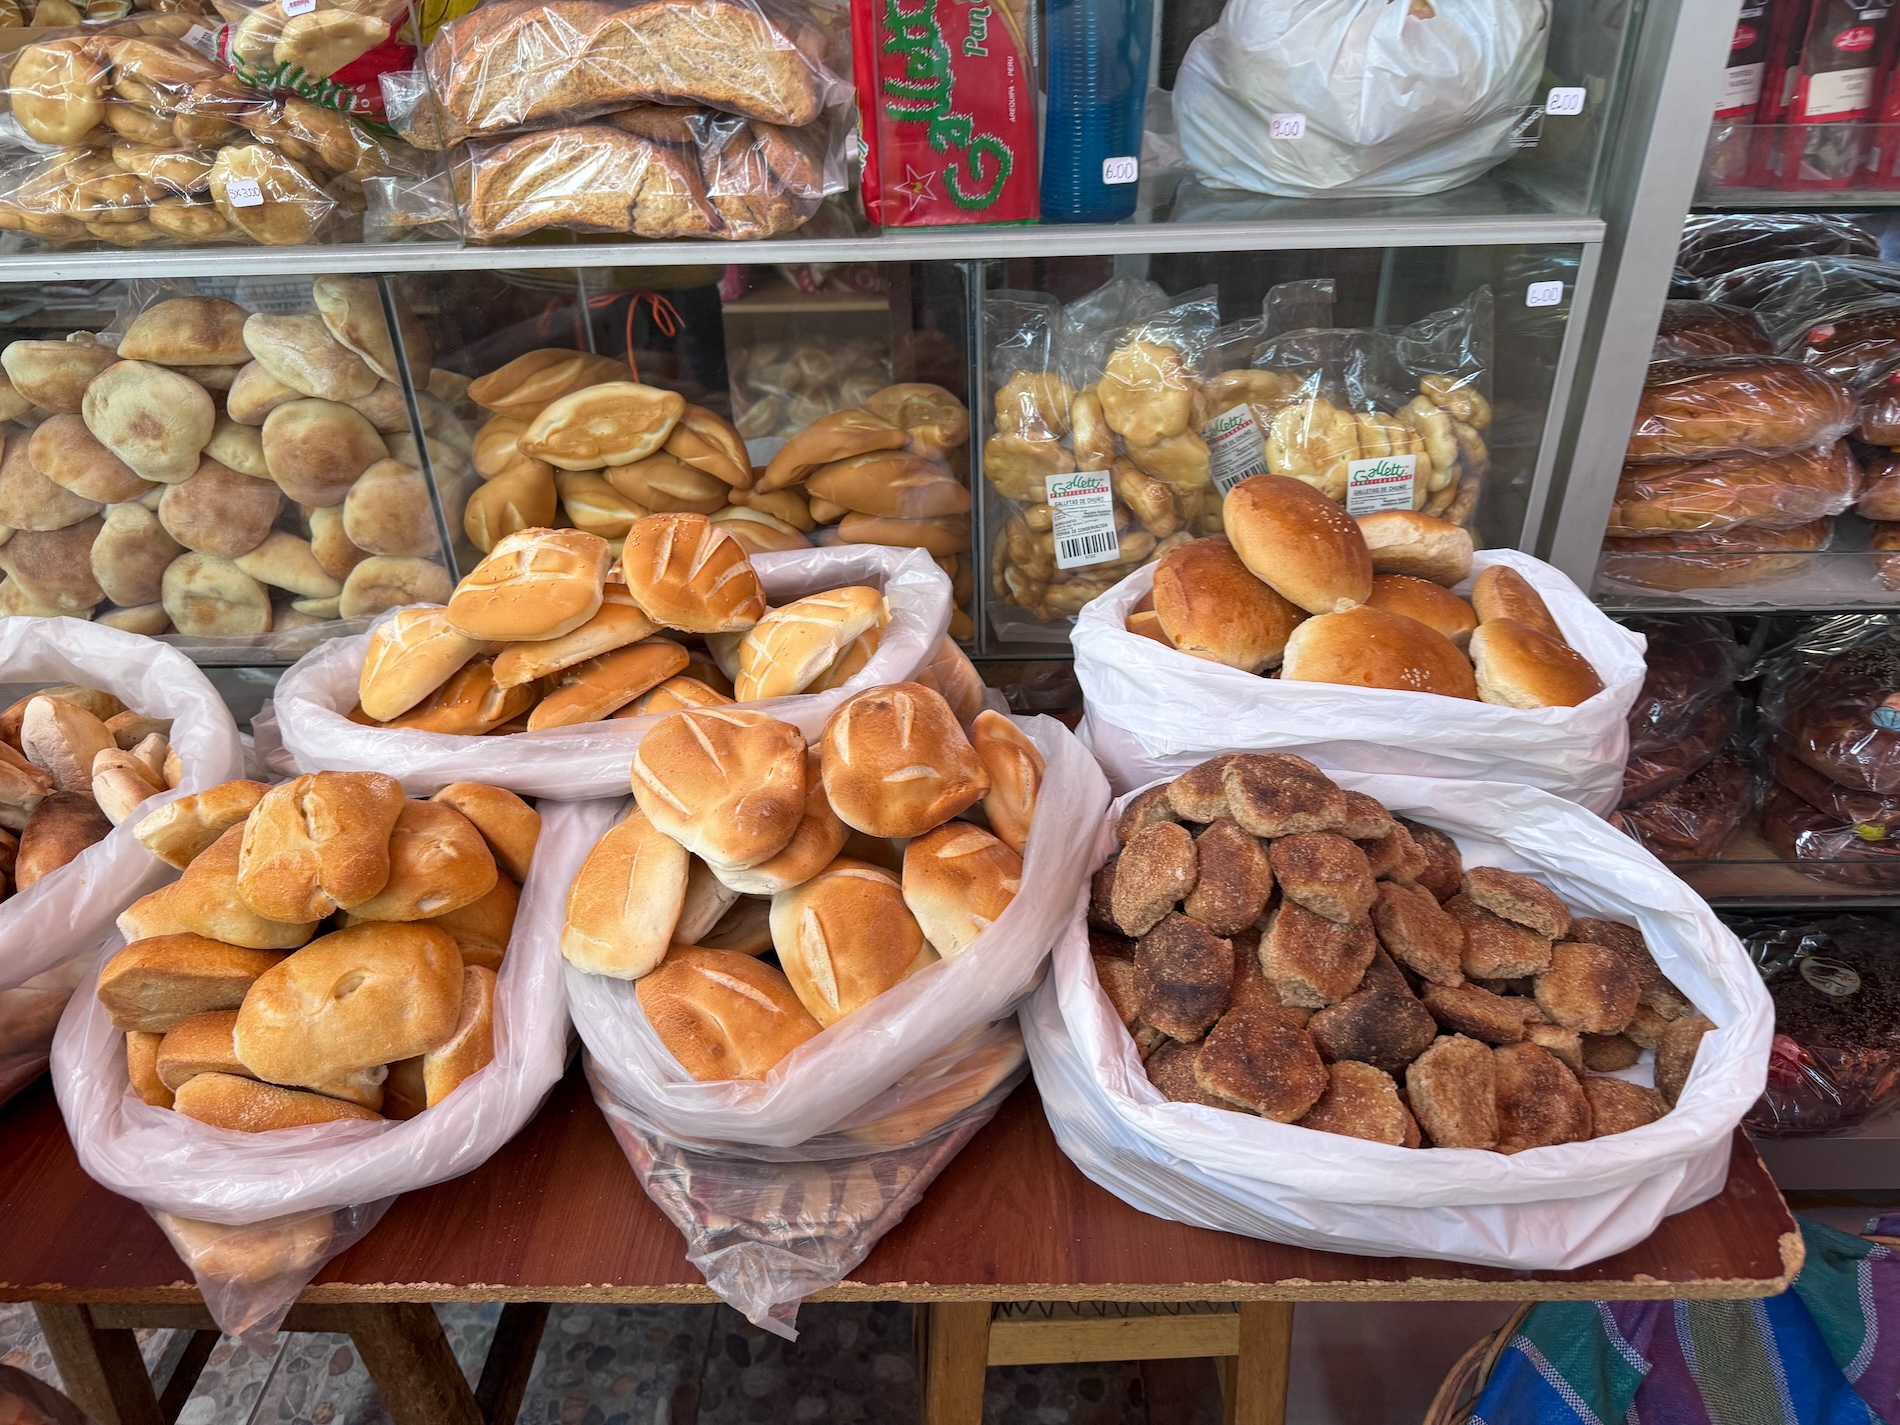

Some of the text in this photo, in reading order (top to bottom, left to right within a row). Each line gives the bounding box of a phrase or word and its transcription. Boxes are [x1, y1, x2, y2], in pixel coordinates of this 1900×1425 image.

[962, 5, 992, 58] Pan
[1007, 55, 1015, 77] PERU
[883, 0, 1014, 211] Gallett
[1008, 85, 1017, 123] AREQUIPA
[1105, 162, 1134, 179] 6.00
